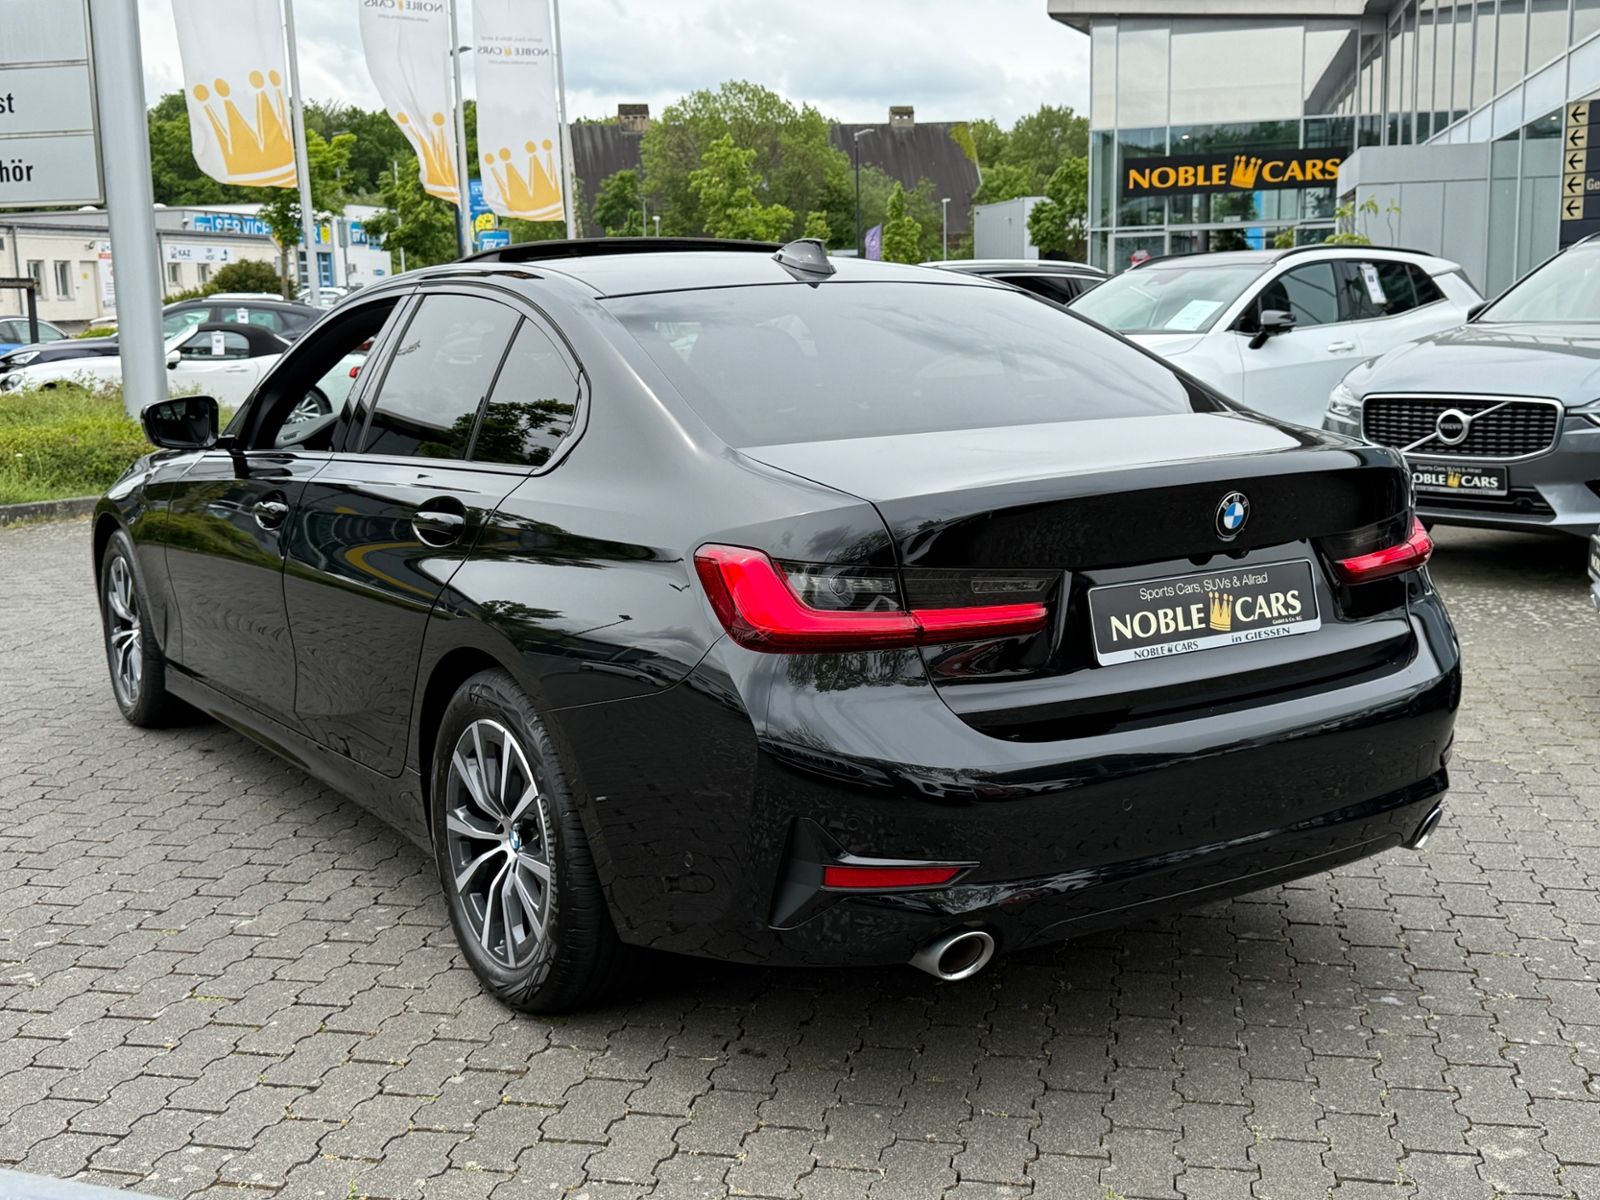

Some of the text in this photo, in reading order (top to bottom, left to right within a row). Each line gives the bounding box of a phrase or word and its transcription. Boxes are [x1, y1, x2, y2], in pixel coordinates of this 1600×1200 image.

[1128, 158, 1341, 190] NOBLE CARS
[1412, 472, 1499, 488] OBLE CARS
[1139, 571, 1268, 602] Sports Cars, SUVs & Allrad
[1110, 589, 1302, 641] NOBLE CARS
[1231, 626, 1291, 643] in GIESSEN
[1134, 640, 1199, 659] NOBLE CARS
